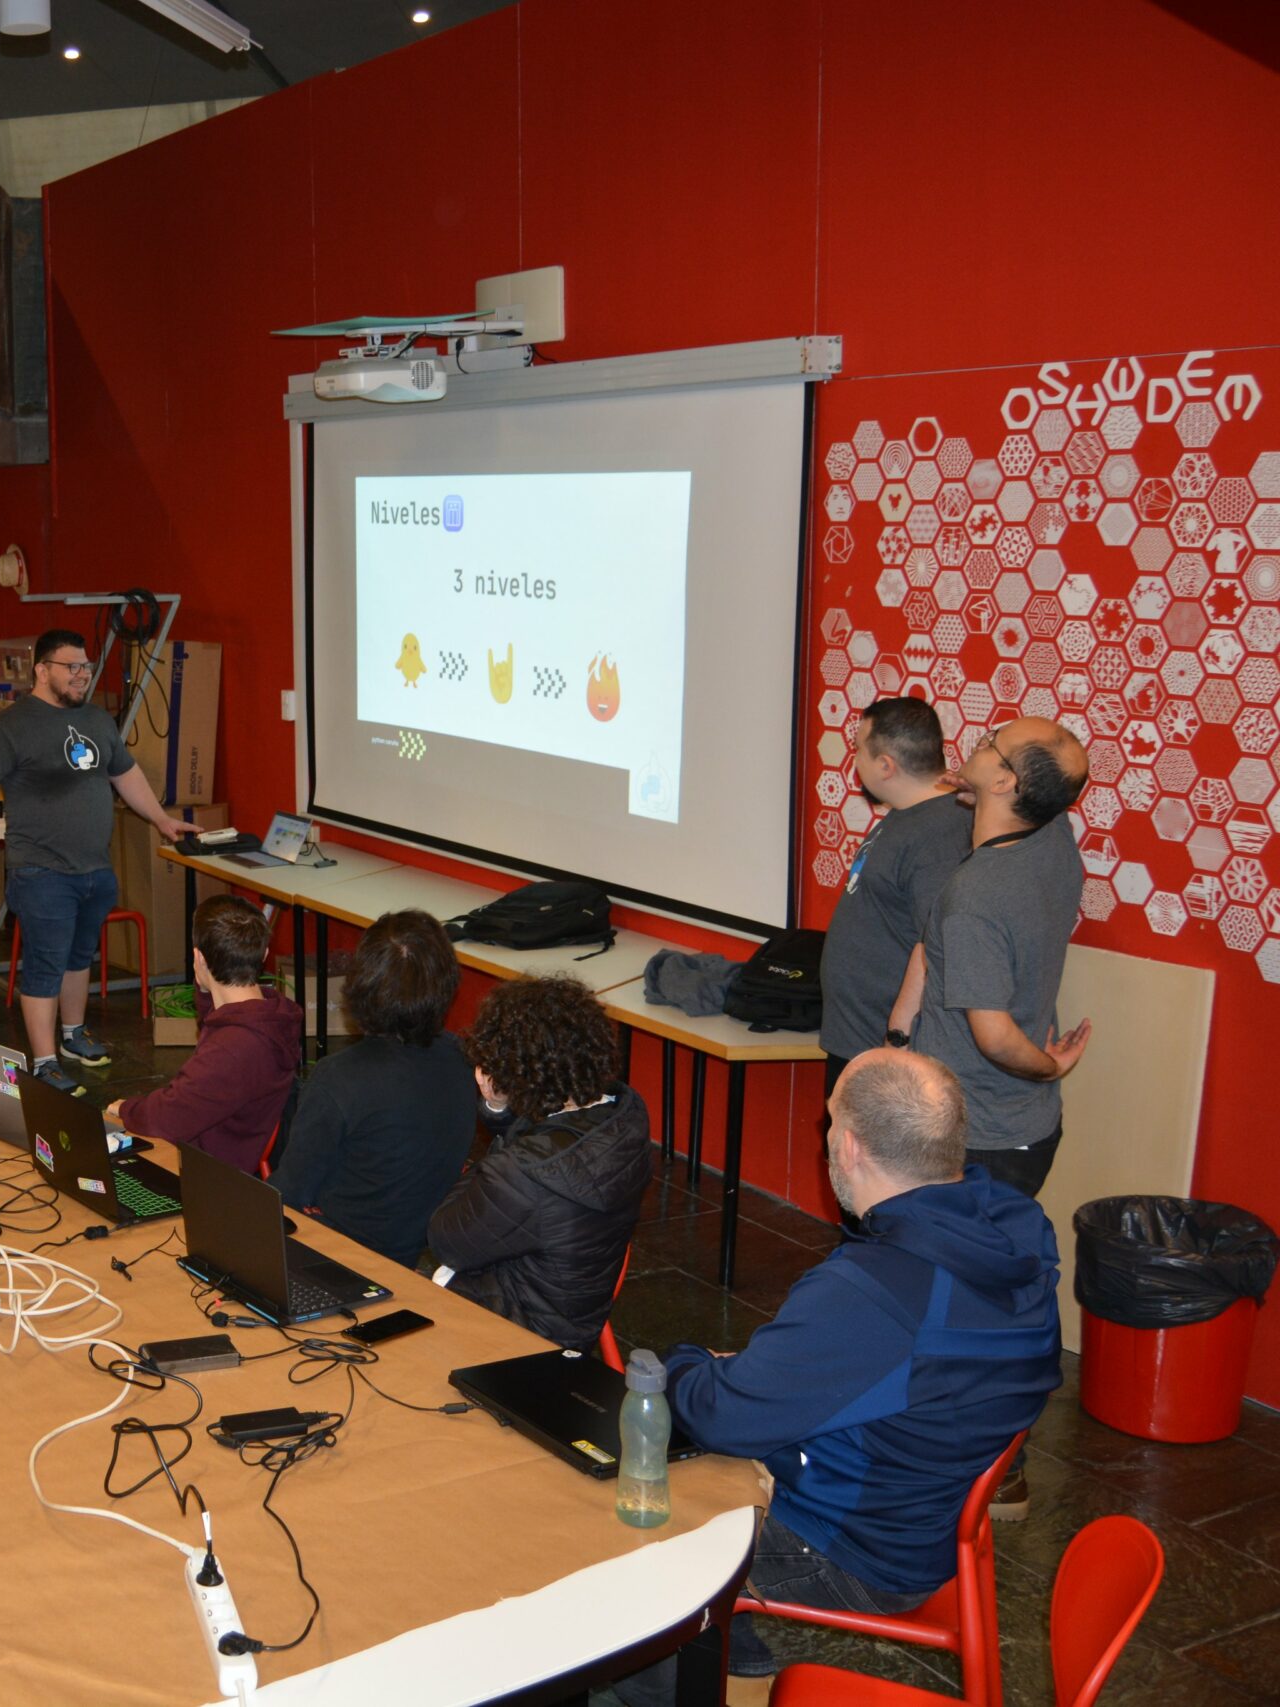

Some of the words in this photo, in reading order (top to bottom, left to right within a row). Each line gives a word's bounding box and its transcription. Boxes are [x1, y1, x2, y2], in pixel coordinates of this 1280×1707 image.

[370, 500, 441, 527] Niveles
[453, 568, 464, 594] 3
[475, 570, 557, 600] niveles
